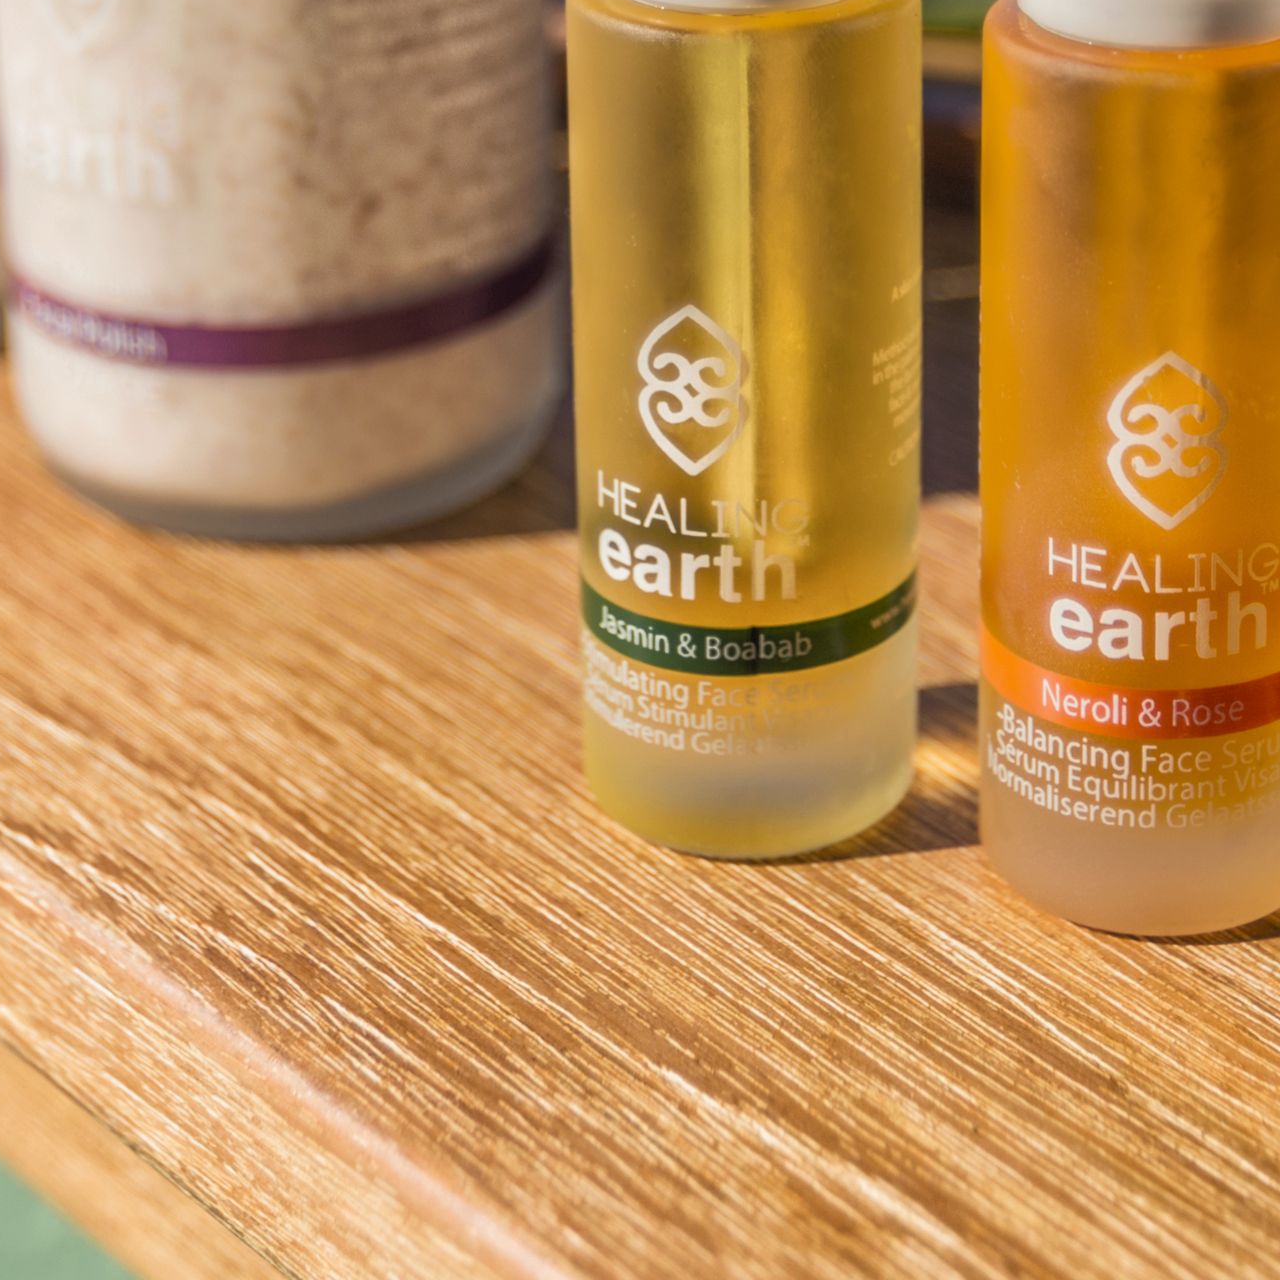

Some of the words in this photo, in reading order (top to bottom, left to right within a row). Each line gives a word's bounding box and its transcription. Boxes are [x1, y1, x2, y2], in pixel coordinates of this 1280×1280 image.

[598, 469, 810, 538] HEALING
[599, 528, 797, 603] earth
[1048, 536, 1280, 594] HEALING
[599, 605, 670, 654] Jasmin
[677, 632, 697, 659] &
[705, 631, 813, 662] Boabab
[1049, 591, 1268, 661] earth
[698, 680, 758, 706] Face
[1041, 677, 1128, 726] Neroli
[1138, 698, 1162, 728] &
[1171, 698, 1245, 727] Rose
[996, 729, 1059, 784] Sérum
[1067, 765, 1227, 802] Equilibrant
[1141, 744, 1212, 773] Face
